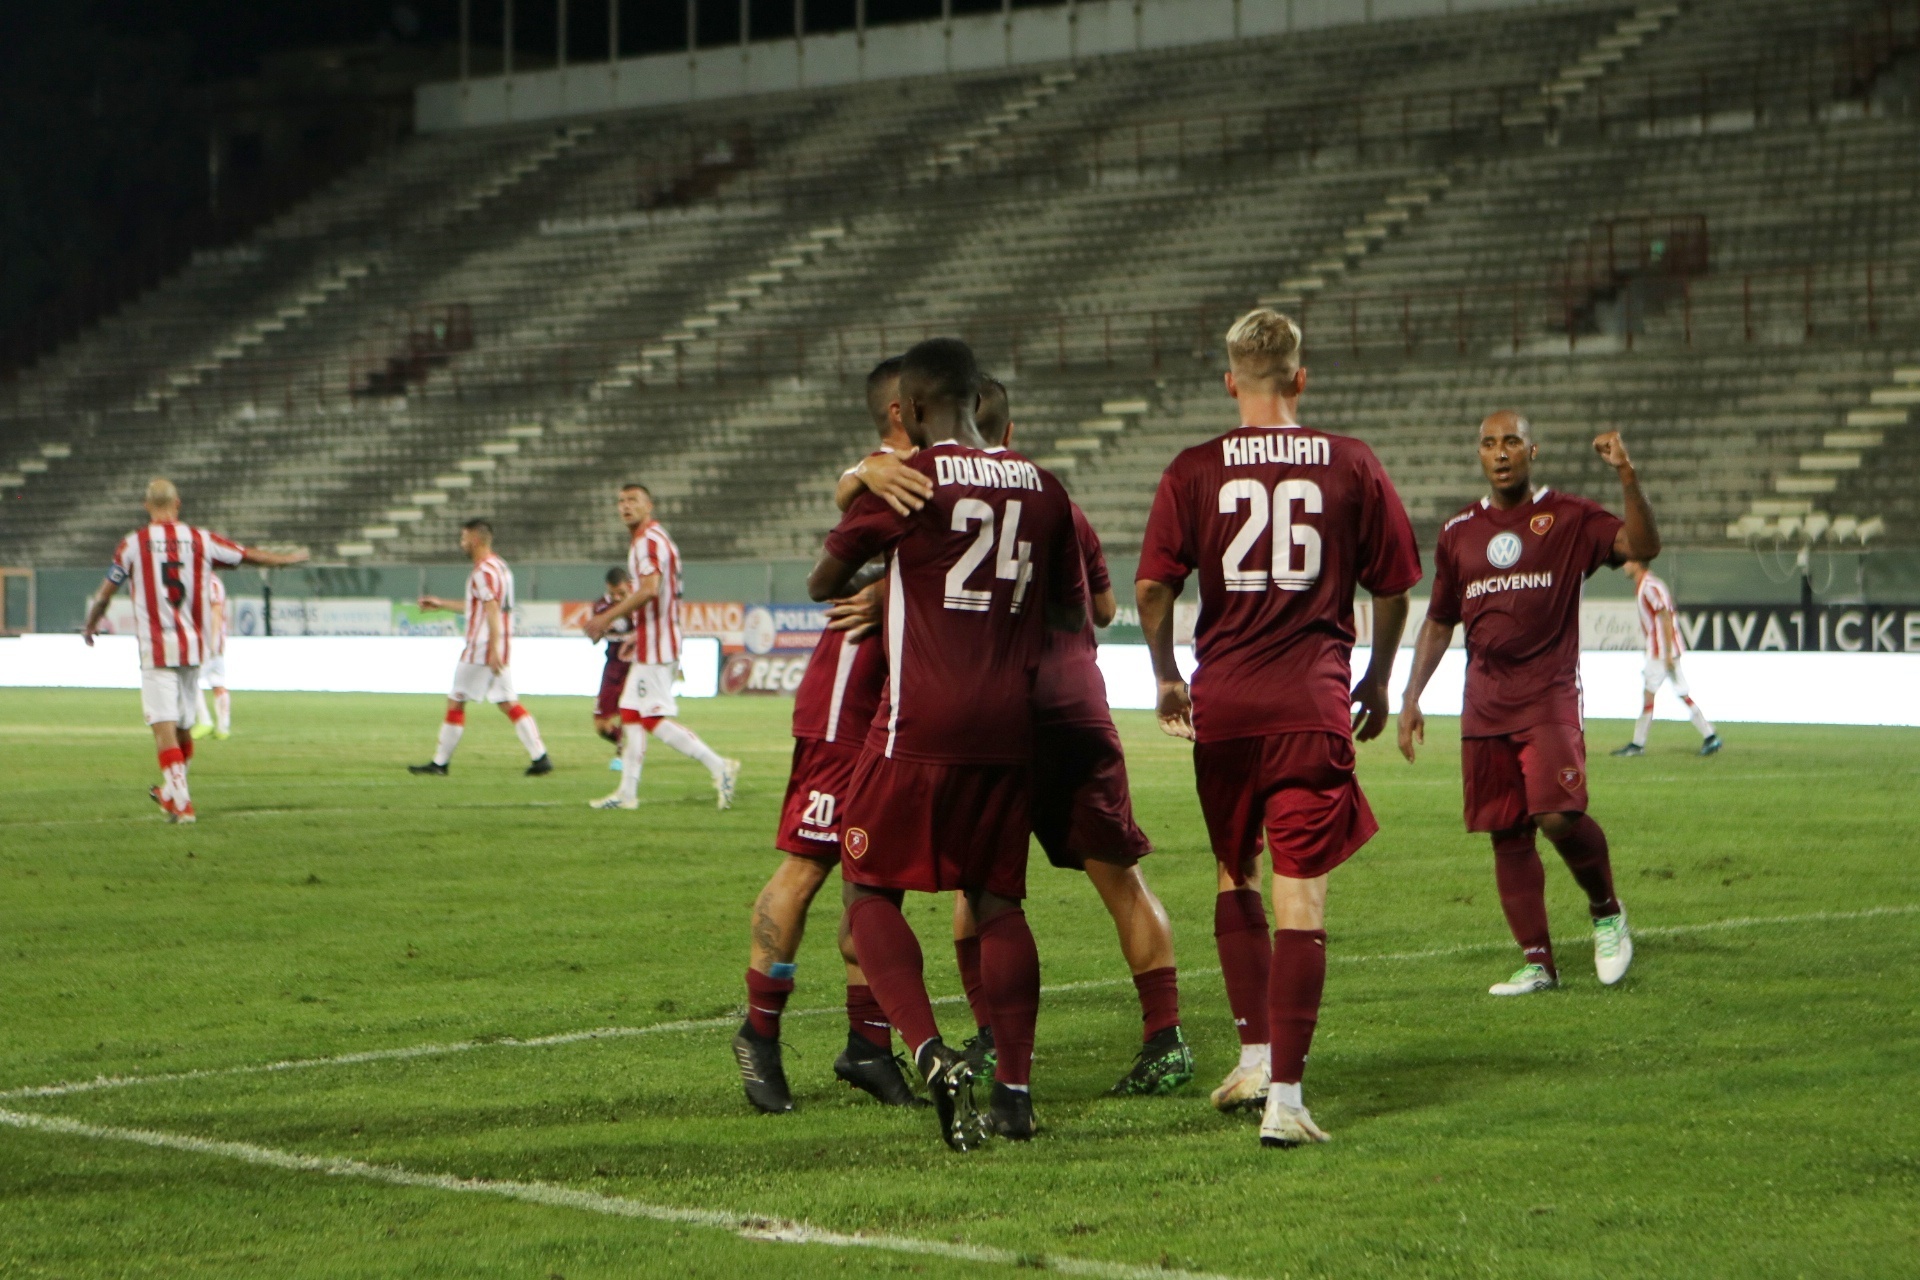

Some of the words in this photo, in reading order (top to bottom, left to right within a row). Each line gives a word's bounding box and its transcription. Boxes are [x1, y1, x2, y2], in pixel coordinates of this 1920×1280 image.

[1222, 434, 1330, 467] KIRWAN
[934, 456, 1043, 492] DOUMBIA
[1218, 479, 1323, 592] 26
[943, 498, 1033, 614] 24
[160, 562, 187, 609] 5
[1465, 571, 1553, 600] BENCIVENNI
[637, 679, 648, 698] 6
[747, 655, 808, 691] REG
[801, 789, 836, 828] 20
[797, 828, 839, 843] LEGEA
